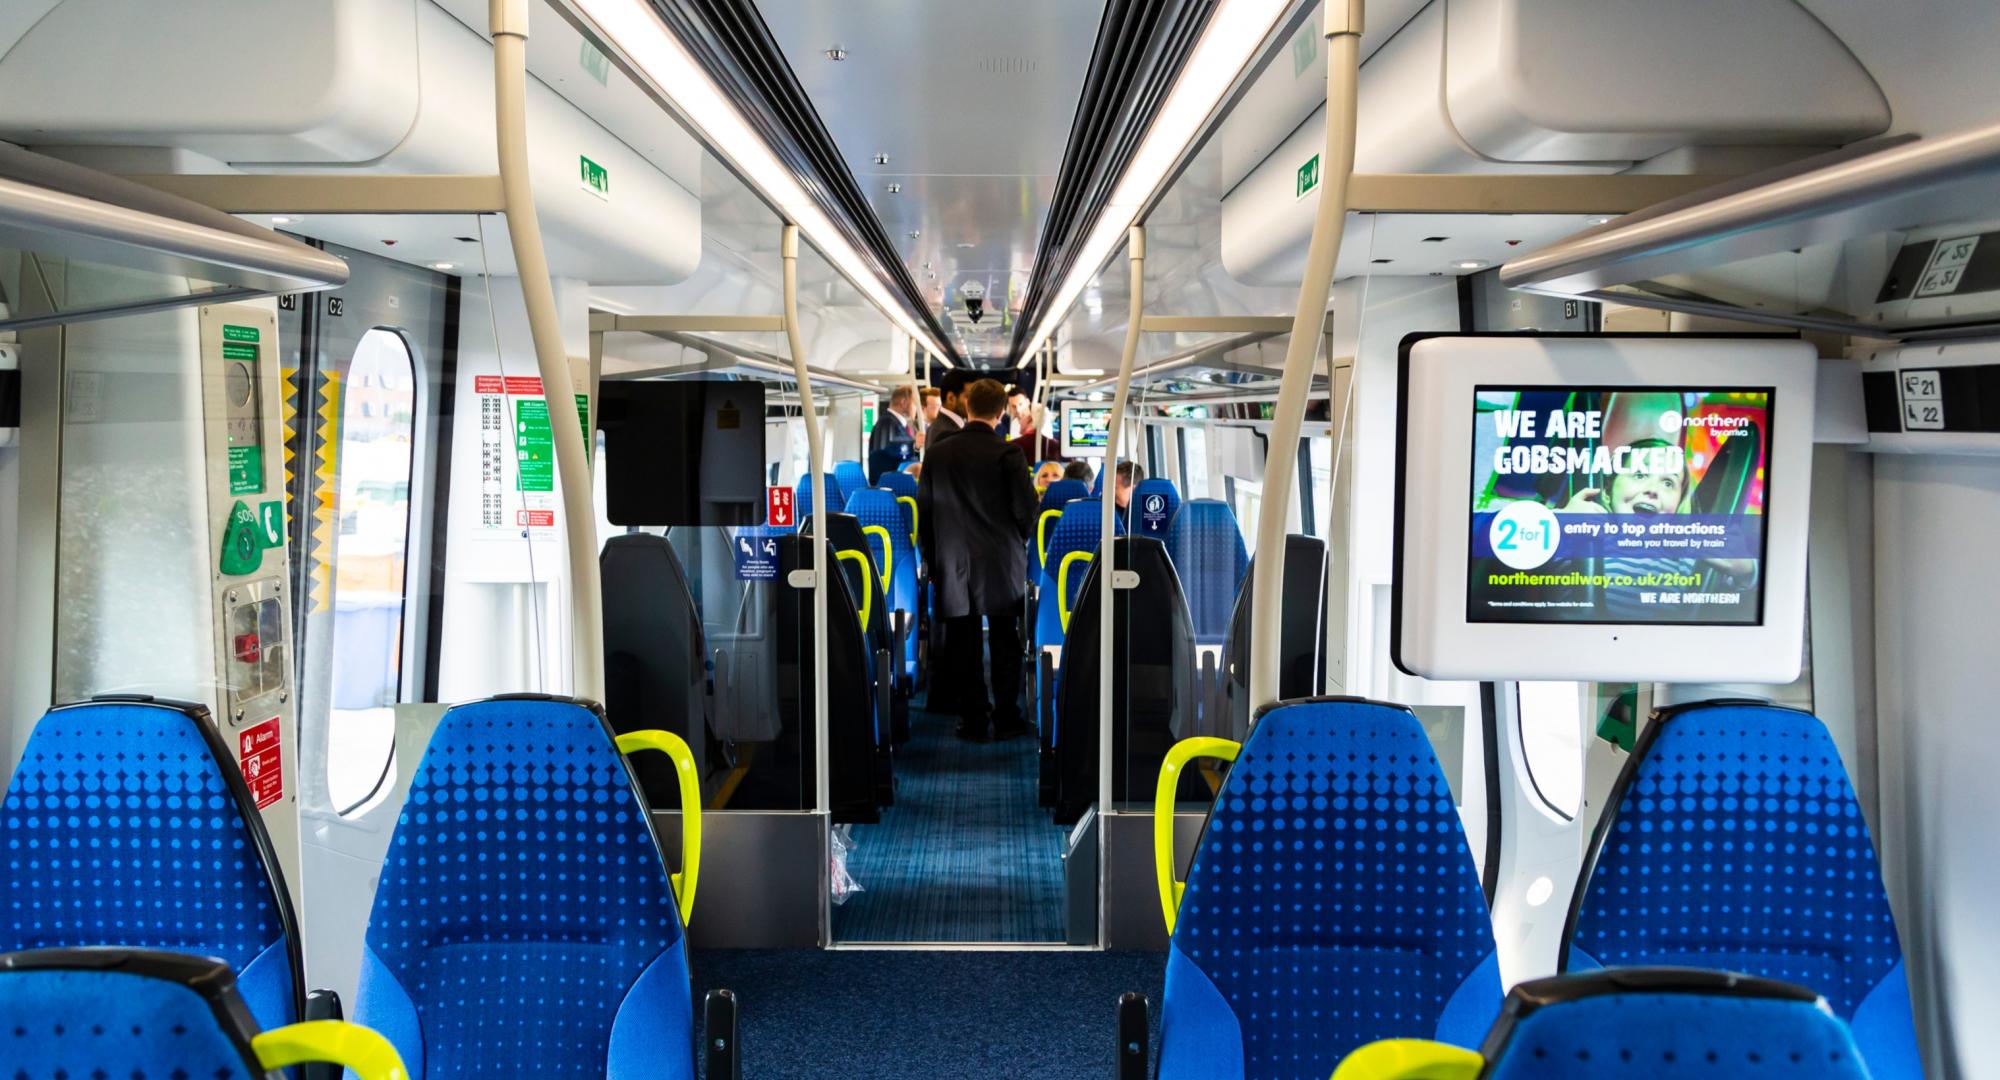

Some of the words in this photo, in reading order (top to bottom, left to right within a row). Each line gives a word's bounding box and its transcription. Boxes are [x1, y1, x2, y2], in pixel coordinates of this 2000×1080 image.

[280, 294, 294, 308] C1
[329, 299, 342, 314] C2
[1566, 302, 1576, 317] B1
[1922, 380, 1935, 395] 21
[1683, 414, 1748, 426] northern
[1923, 407, 1938, 422] 22
[1494, 411, 1536, 438] WE
[1544, 410, 1601, 438] ARE
[1494, 446, 1684, 475] GOBSMACKED
[236, 510, 254, 524] SOS
[1564, 522, 1600, 536] entry
[1604, 522, 1618, 534] to
[1622, 522, 1644, 536] top
[1649, 522, 1725, 534] attractions
[1618, 538, 1642, 548] when
[1644, 540, 1661, 549] you
[1663, 538, 1688, 548] travel
[1690, 538, 1702, 549] by
[1488, 572, 1702, 588] northernrailway.co.uk/2for1
[1640, 592, 1656, 604] WE
[1659, 592, 1680, 604] ARE
[1683, 593, 1740, 604] NORTHERN
[256, 730, 273, 744] Alarm
